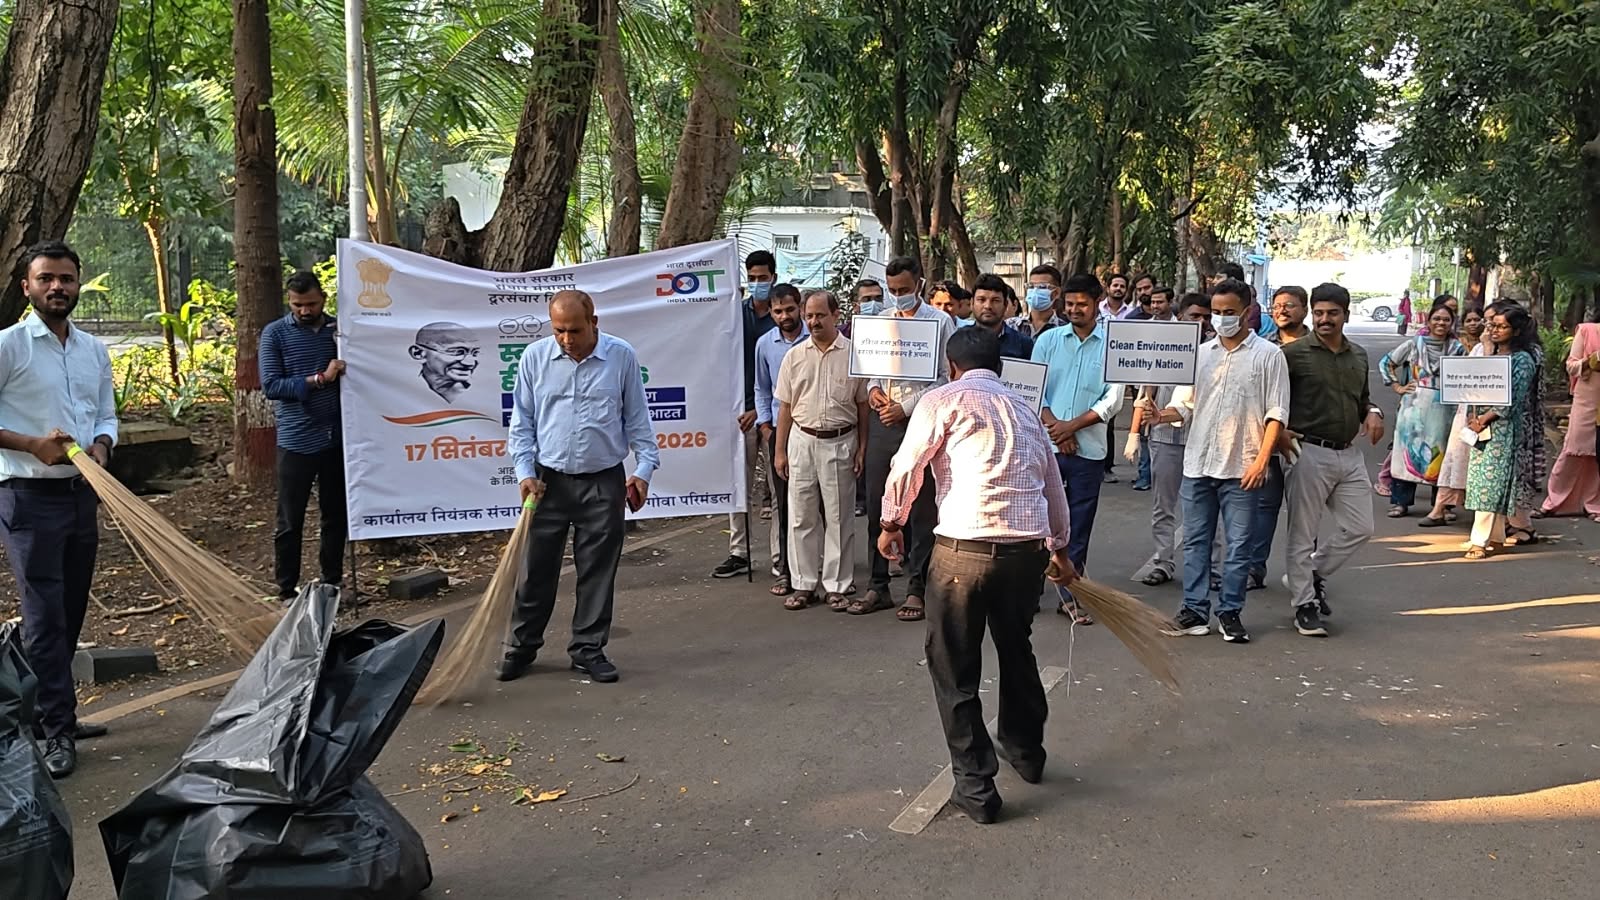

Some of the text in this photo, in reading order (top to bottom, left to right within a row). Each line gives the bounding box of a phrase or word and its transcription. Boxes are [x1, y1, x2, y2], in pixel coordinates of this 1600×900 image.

[494, 273, 575, 284] भारत सरकार
[488, 292, 541, 305] दूरसंचार
[1109, 339, 1194, 353] Clean Environment,
[1118, 357, 1184, 370] Healthy Nation
[649, 408, 682, 419] भारत
[404, 431, 707, 461] 17 सितंबर 2026
[489, 476, 501, 486] के
[362, 509, 428, 526] कार्यालय
[431, 507, 483, 522] नियंत्रक
[645, 493, 677, 507] गोवा
[679, 491, 732, 506] परिमंडल
